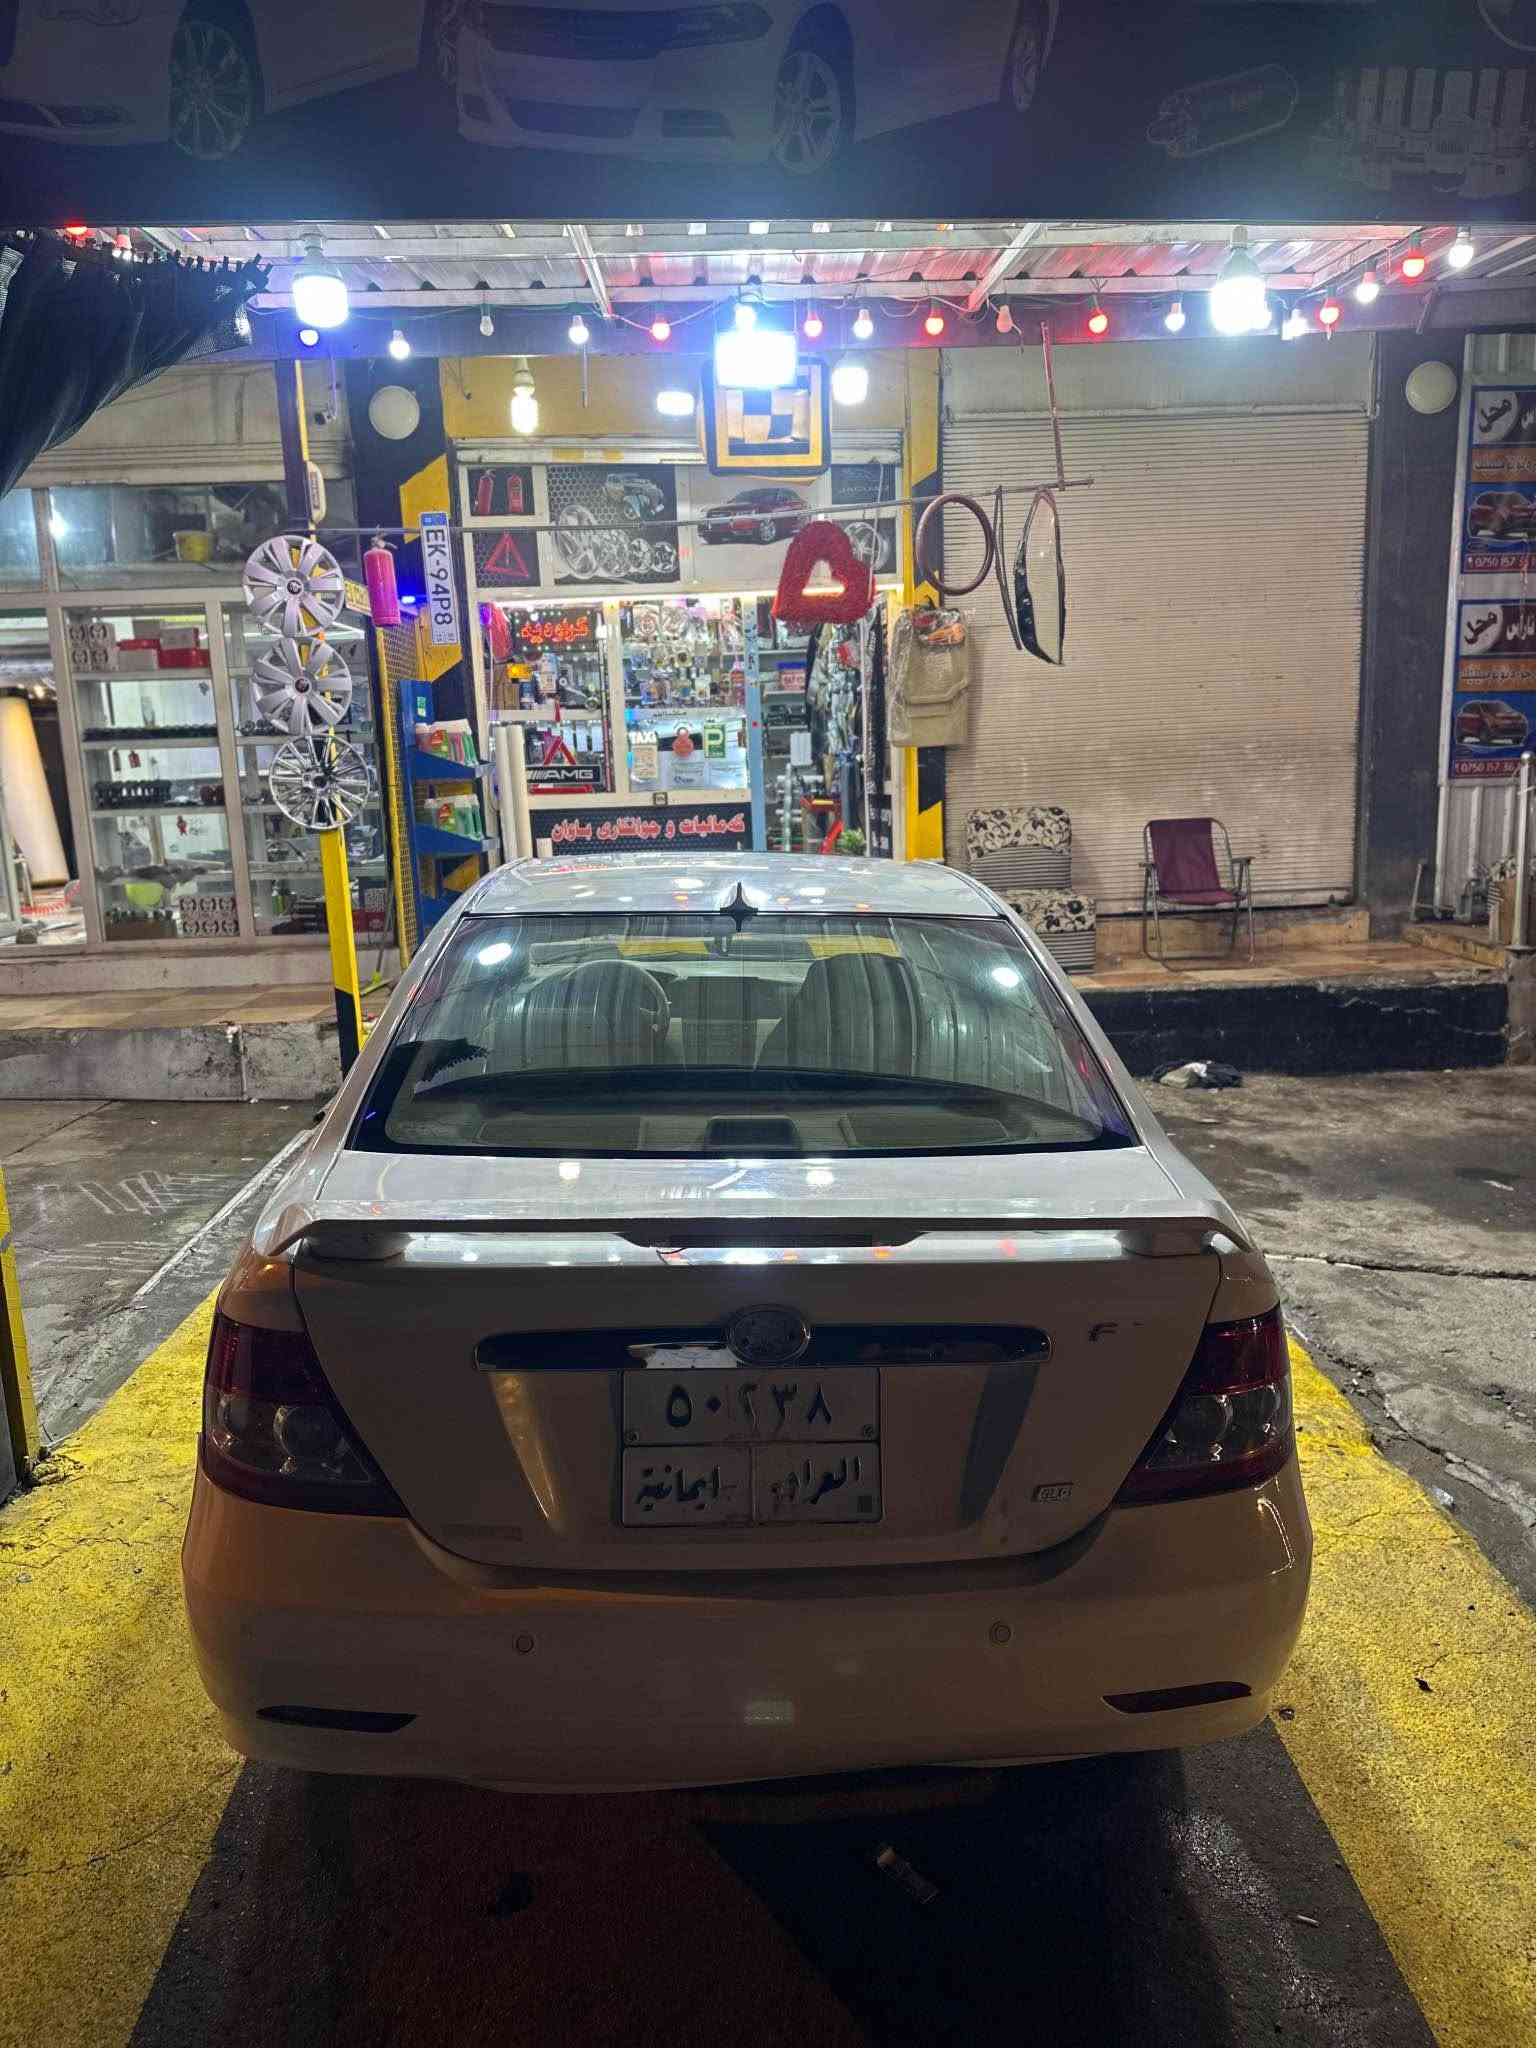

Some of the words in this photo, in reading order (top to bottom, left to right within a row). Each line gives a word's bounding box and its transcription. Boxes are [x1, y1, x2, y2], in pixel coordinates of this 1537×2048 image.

[425, 529, 453, 625] EK-94P8
[664, 819, 676, 840] و
[665, 1381, 834, 1427] ٥٠٢٣٨
